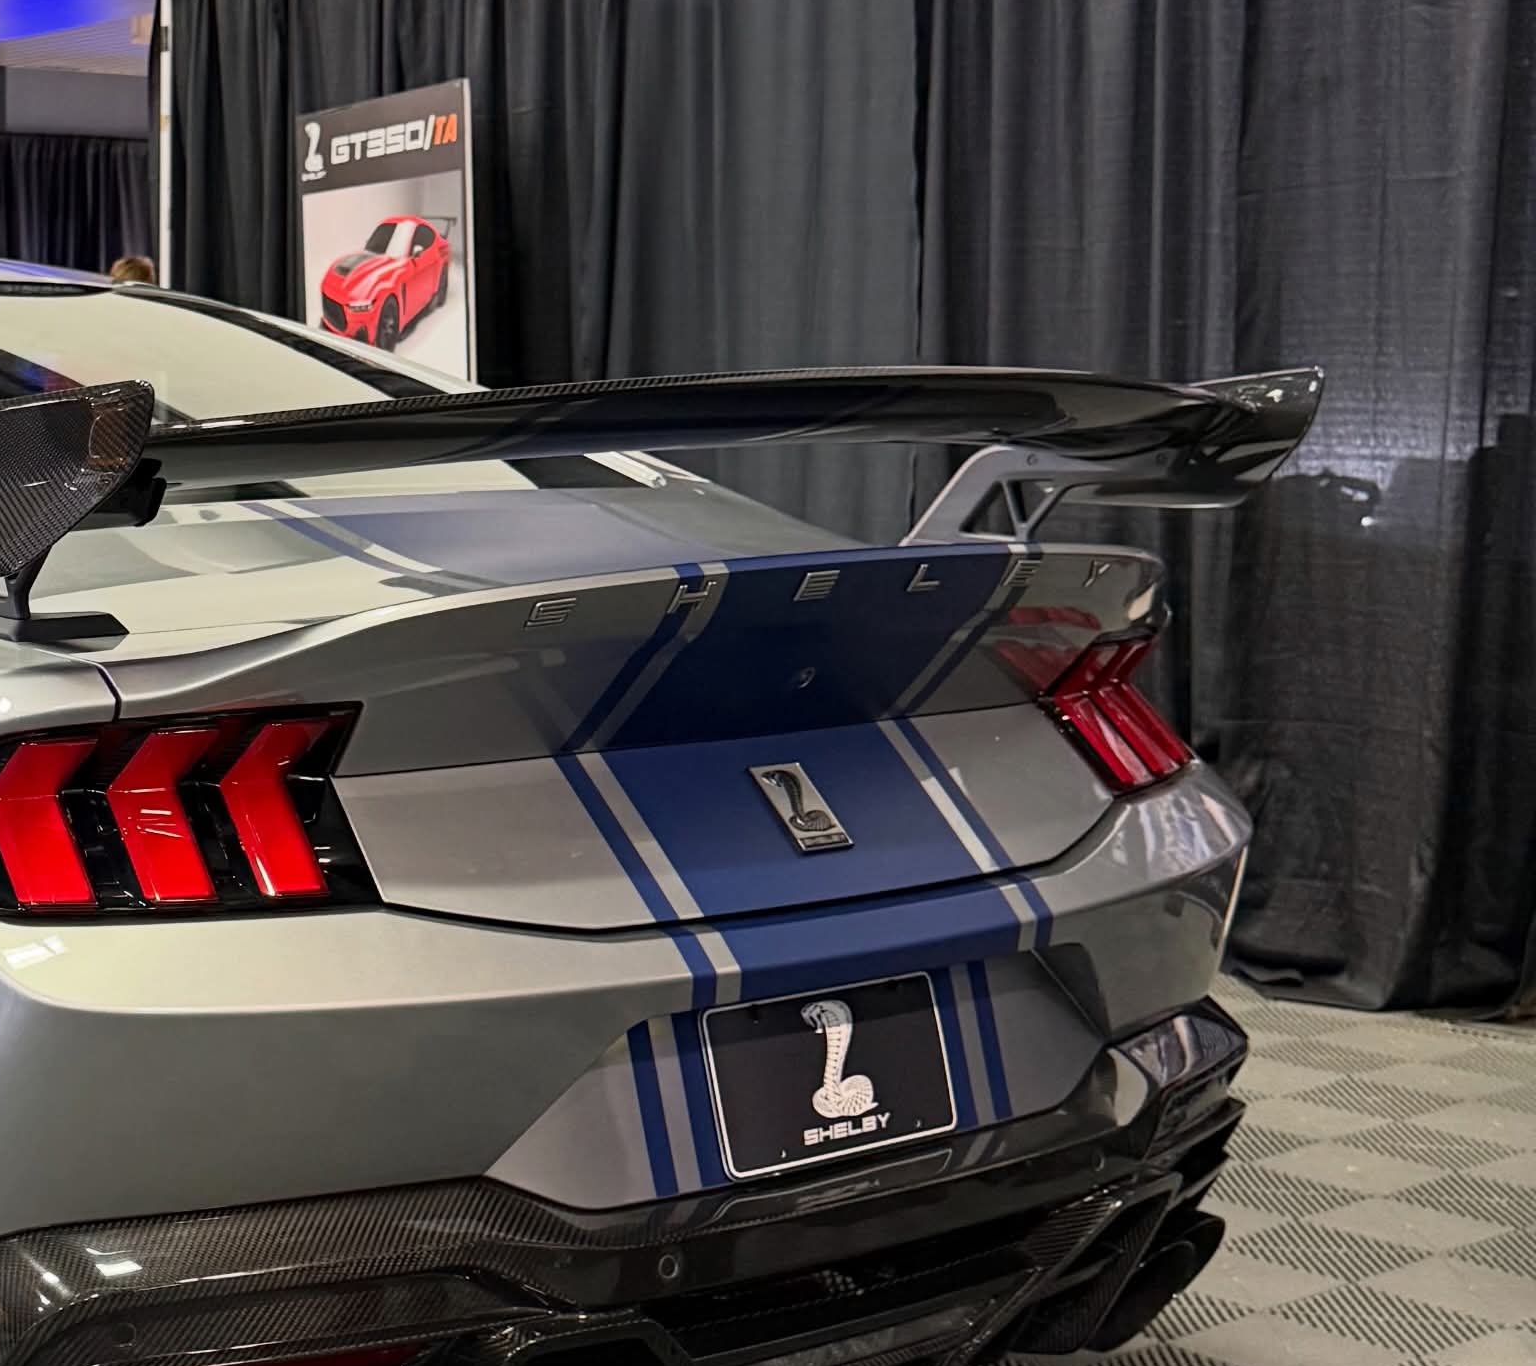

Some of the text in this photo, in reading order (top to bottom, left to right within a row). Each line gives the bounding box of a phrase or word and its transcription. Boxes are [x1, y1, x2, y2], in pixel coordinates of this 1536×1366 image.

[331, 114, 457, 165] GT350/TA
[524, 559, 1110, 628] SHELBY
[804, 1112, 891, 1146] SHELBY
